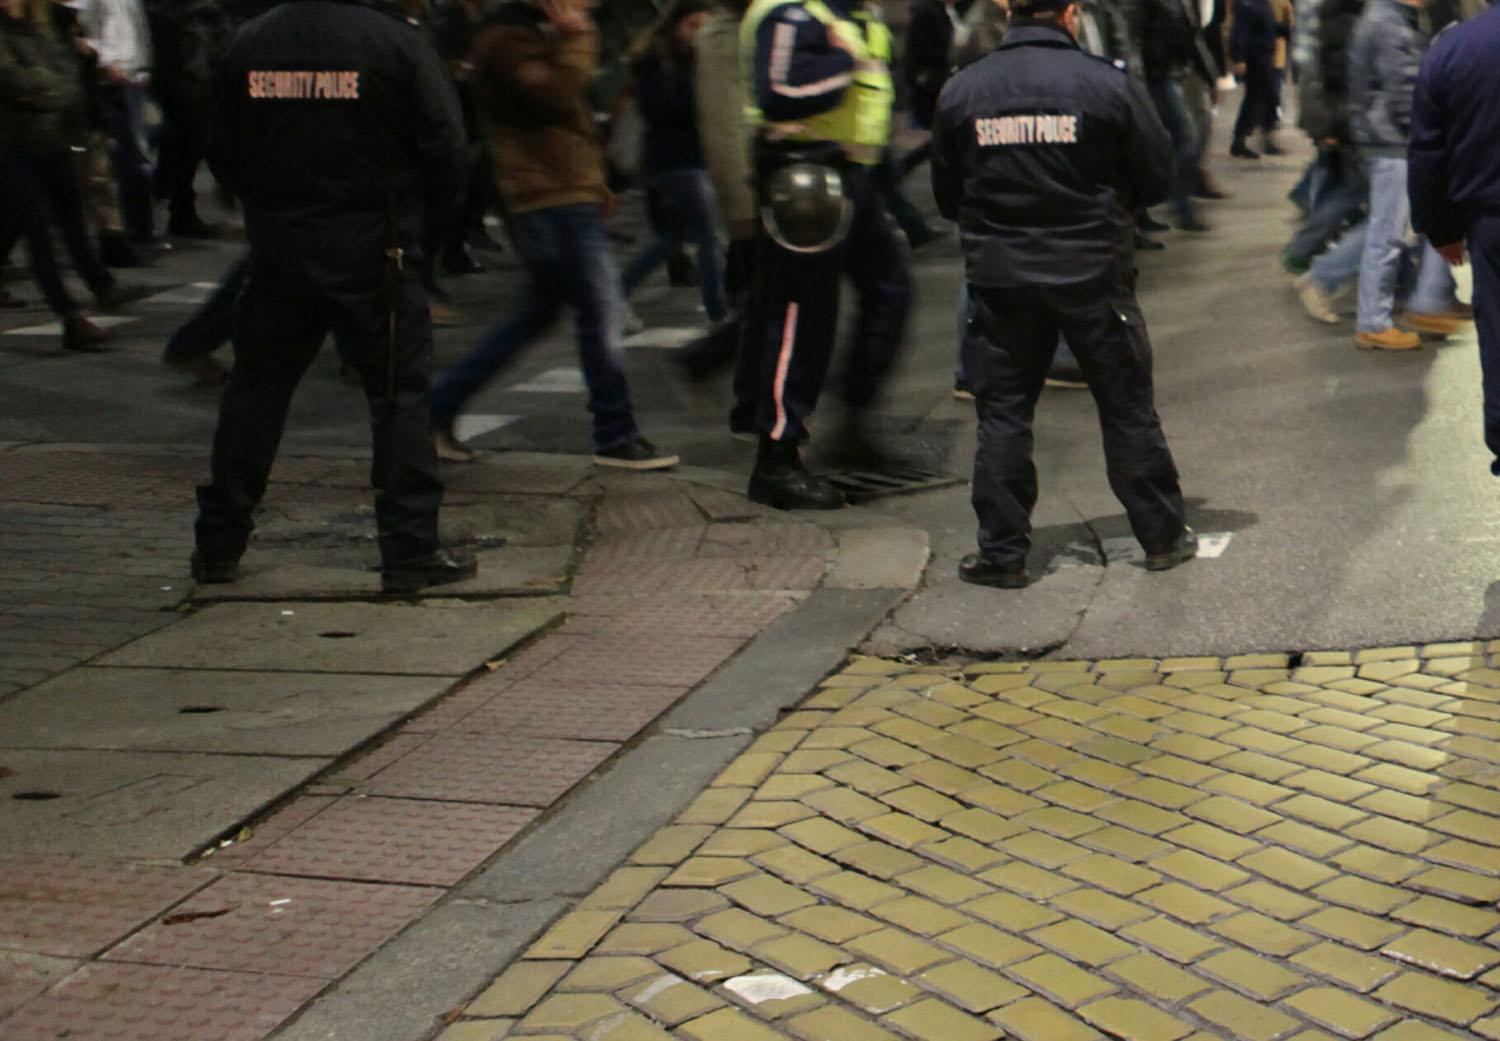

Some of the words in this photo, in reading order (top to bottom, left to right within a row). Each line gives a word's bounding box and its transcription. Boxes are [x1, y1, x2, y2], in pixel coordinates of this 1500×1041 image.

[248, 71, 314, 98] SECURITY
[314, 71, 359, 98] POLICE
[976, 116, 1034, 146] SECURITY
[1036, 115, 1077, 143] POLICE
